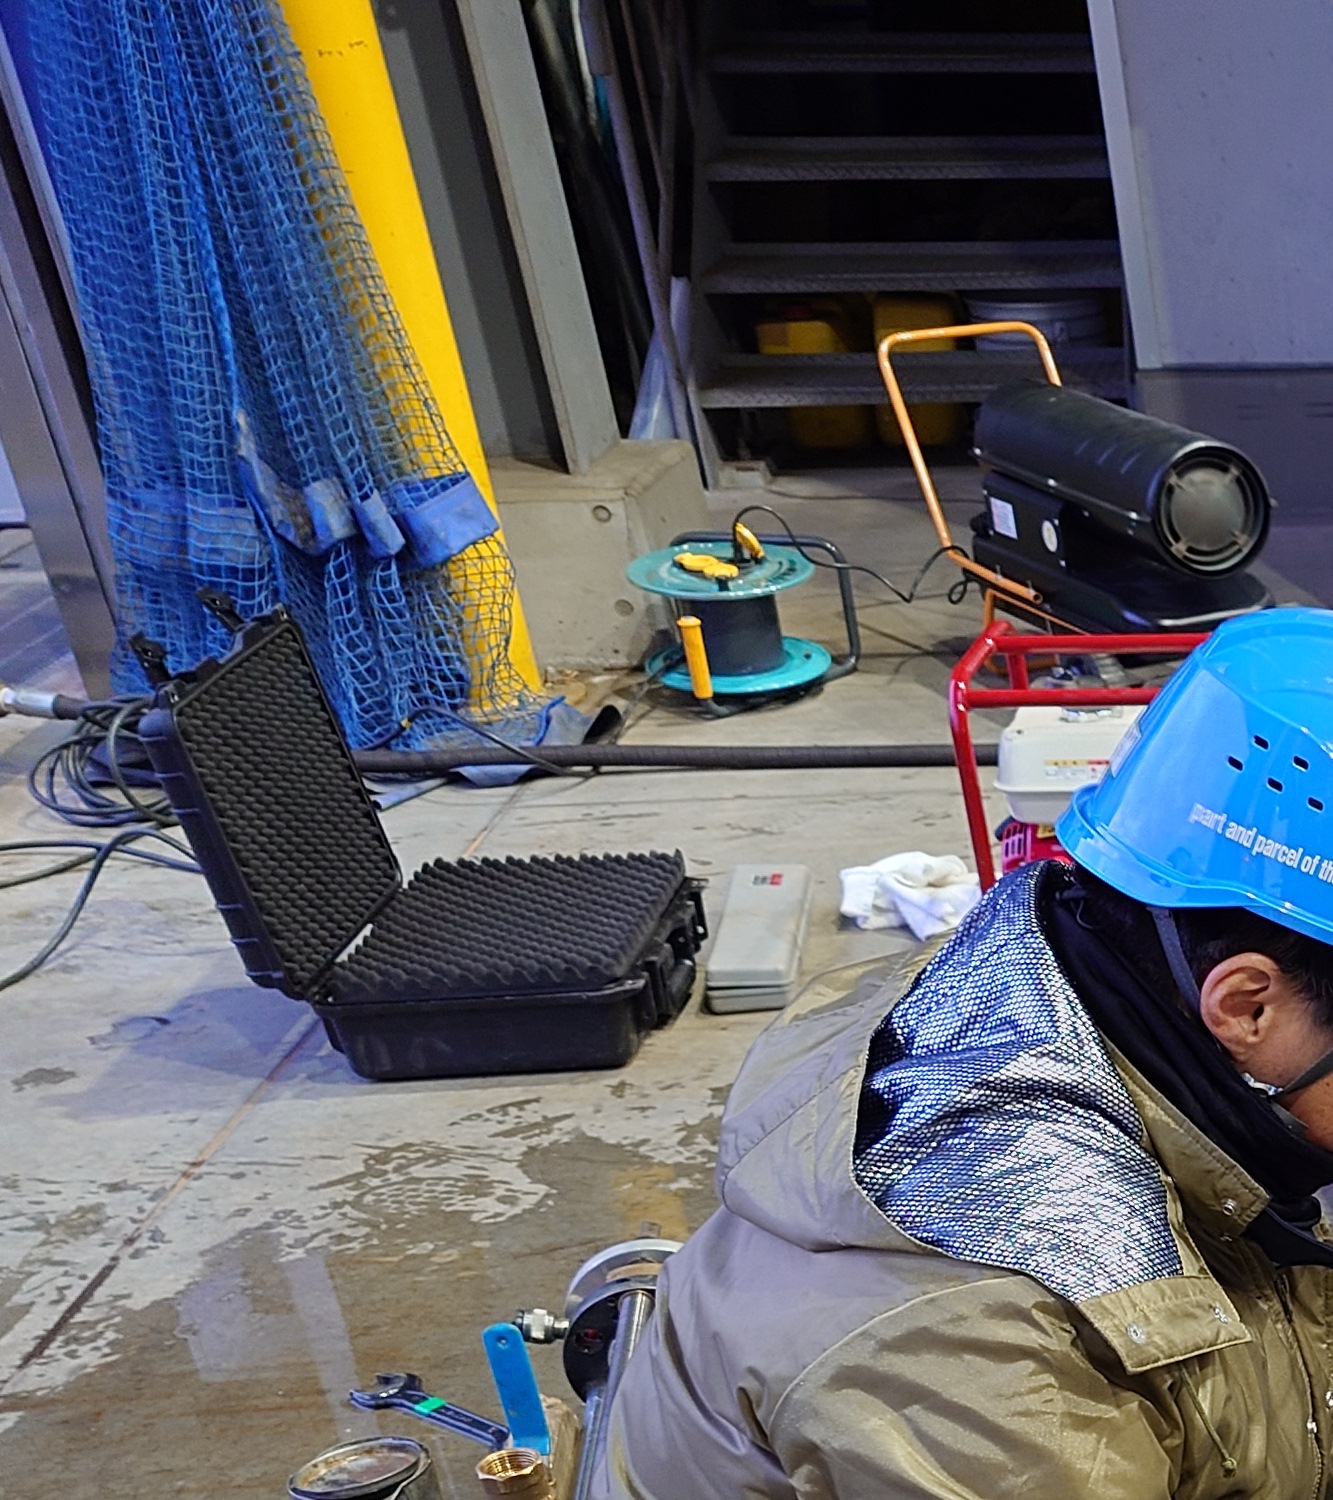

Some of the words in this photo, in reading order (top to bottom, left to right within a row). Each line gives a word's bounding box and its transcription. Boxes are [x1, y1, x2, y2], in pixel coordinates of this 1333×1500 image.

[1188, 802, 1227, 834] part
[1225, 821, 1258, 849] and
[1252, 832, 1304, 869] parcel
[1301, 855, 1321, 876] of
